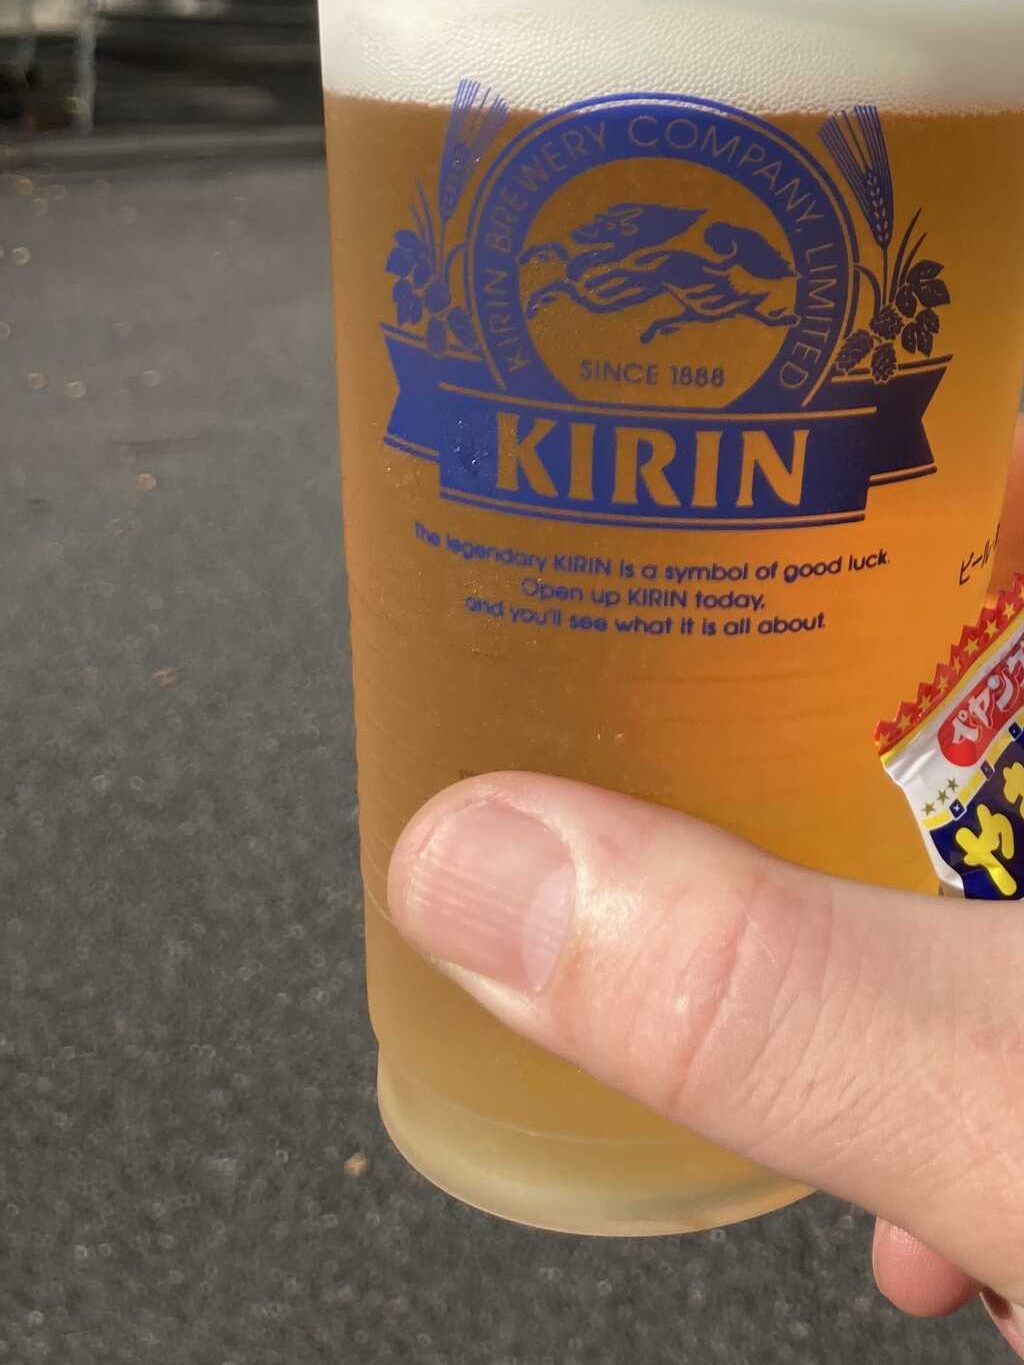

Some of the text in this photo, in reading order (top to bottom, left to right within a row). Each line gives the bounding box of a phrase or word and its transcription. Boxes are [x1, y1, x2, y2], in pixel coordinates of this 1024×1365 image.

[485, 122, 607, 254] BREWERY
[484, 268, 531, 373] KIRIN
[779, 242, 842, 390] LIMITED
[579, 359, 725, 388] SINCE 1888
[495, 411, 810, 508] KIRIN
[414, 521, 441, 548] The
[446, 533, 547, 572] legendary
[553, 553, 612, 576] KIRIN
[620, 558, 634, 578] is
[641, 564, 657, 579] a
[664, 562, 748, 584] symbol
[755, 561, 778, 580] of
[783, 555, 842, 583] good
[521, 577, 584, 601] Open
[591, 589, 621, 607] up
[628, 588, 688, 608] KIRIN
[464, 596, 503, 618] and
[509, 605, 562, 626] you'll
[570, 614, 608, 632] see
[614, 617, 672, 634] what
[680, 618, 695, 634] it
[702, 618, 717, 636] is
[723, 618, 751, 635] all
